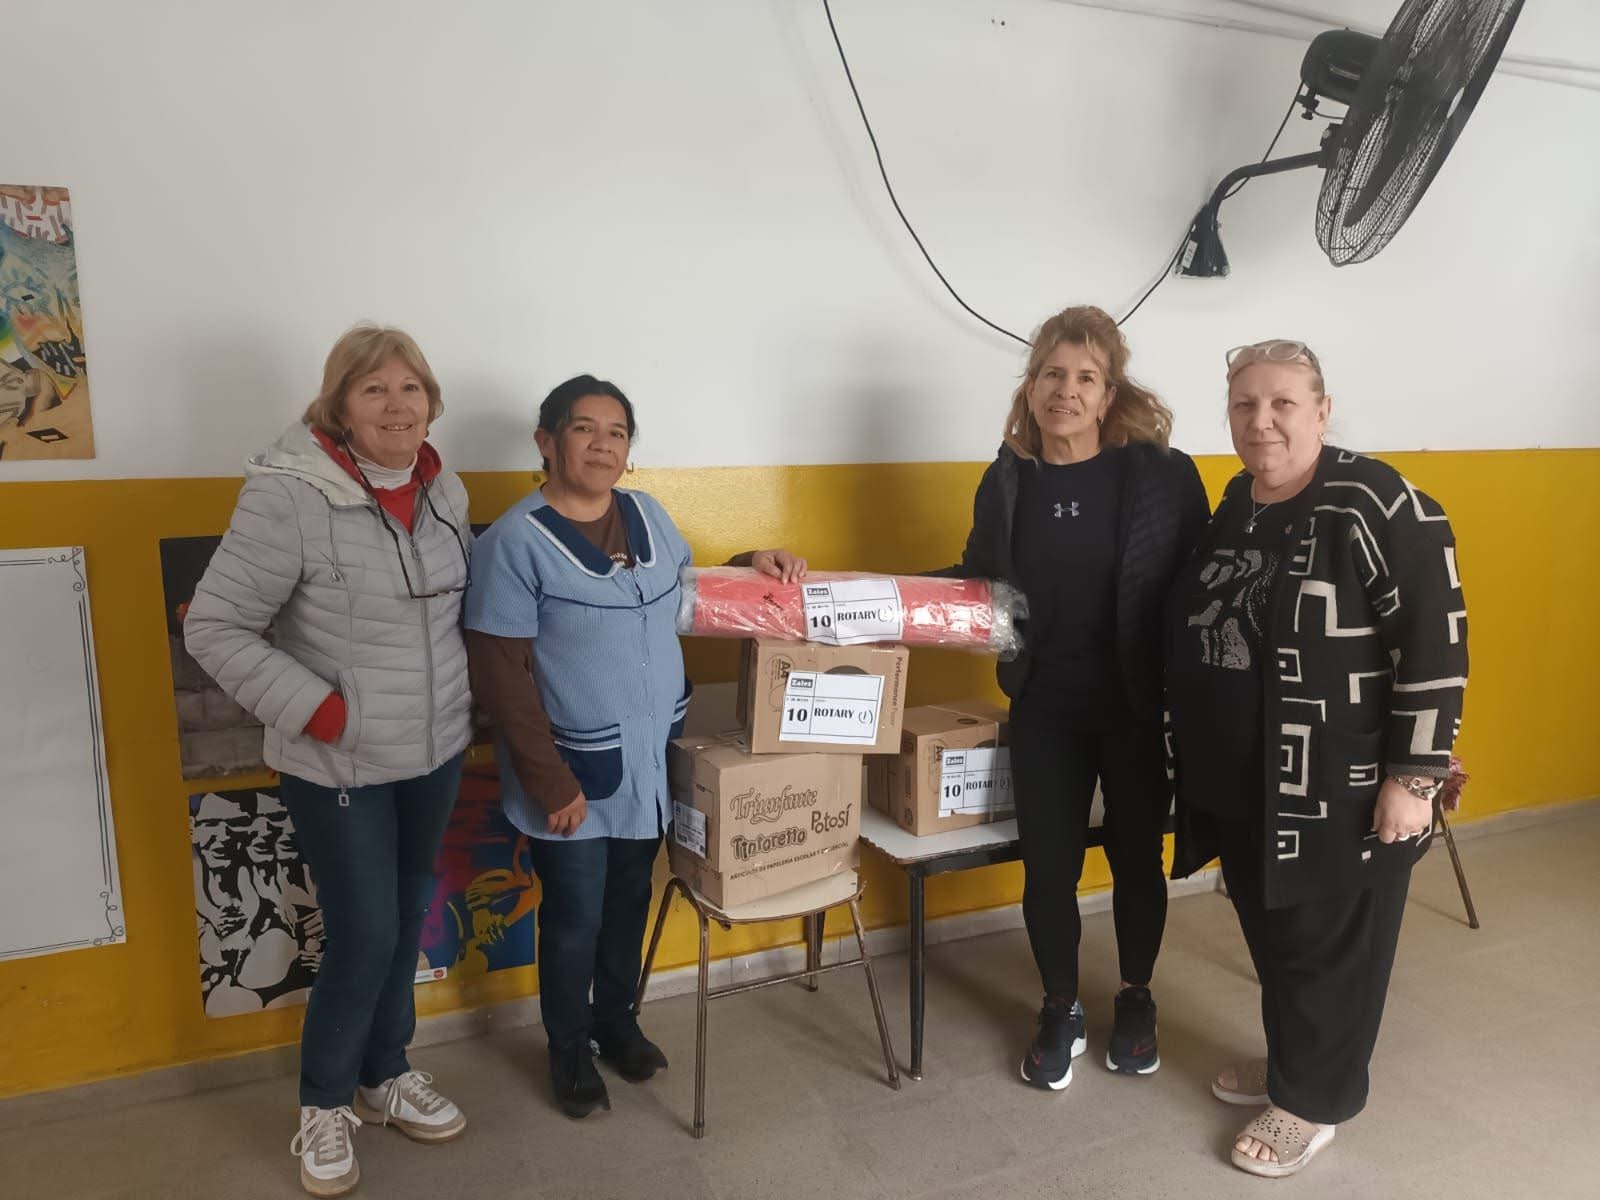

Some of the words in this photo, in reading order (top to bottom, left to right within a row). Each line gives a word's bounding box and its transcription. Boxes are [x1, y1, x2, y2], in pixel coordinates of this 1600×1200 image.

[810, 615, 831, 628] 10
[837, 610, 877, 622] ROTARY
[787, 708, 808, 722] 10
[814, 707, 855, 719] ROTARY
[944, 784, 961, 798] 10
[730, 785, 818, 825] Triumfante
[731, 827, 808, 861] Tintoretto
[820, 841, 849, 855] CERCIAL
